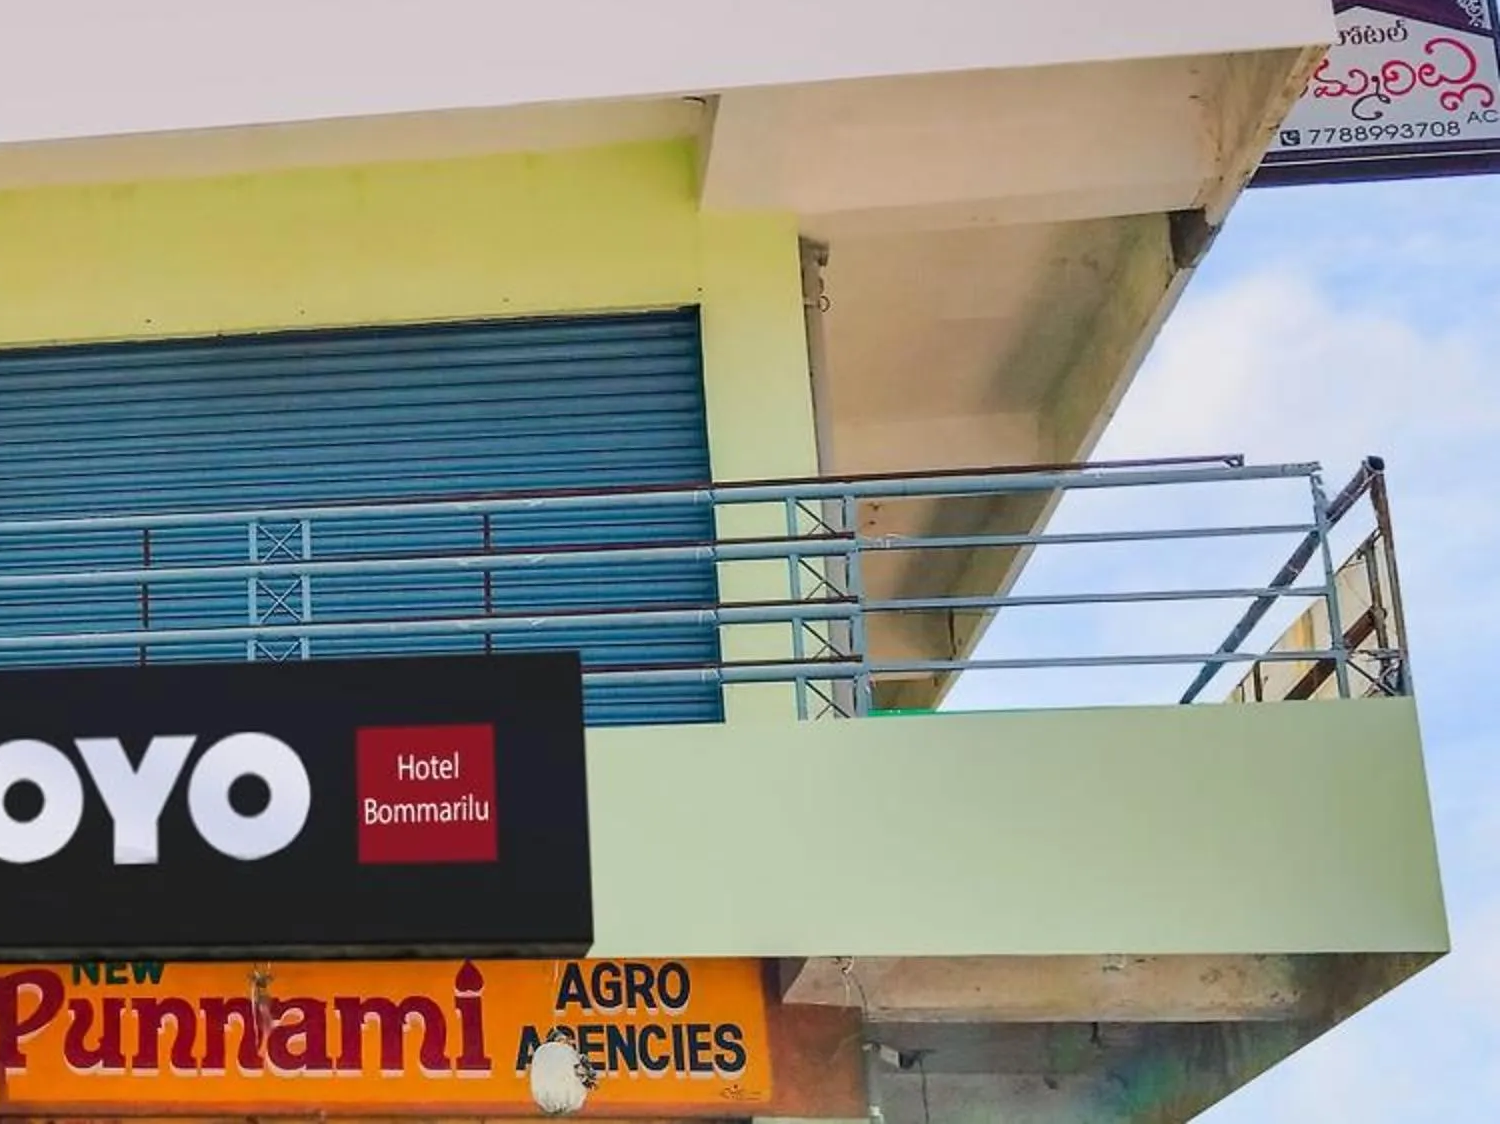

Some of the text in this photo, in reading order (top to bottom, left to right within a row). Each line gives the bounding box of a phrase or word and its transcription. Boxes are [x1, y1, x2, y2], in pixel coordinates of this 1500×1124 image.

[1467, 109, 1500, 125] AC
[1308, 121, 1462, 145] 7788993708
[397, 750, 460, 781] Hotel
[363, 792, 490, 826] Bommarilu
[71, 961, 165, 986] NEW
[554, 960, 692, 1014] AGRO
[515, 1022, 748, 1075] AENCIES
